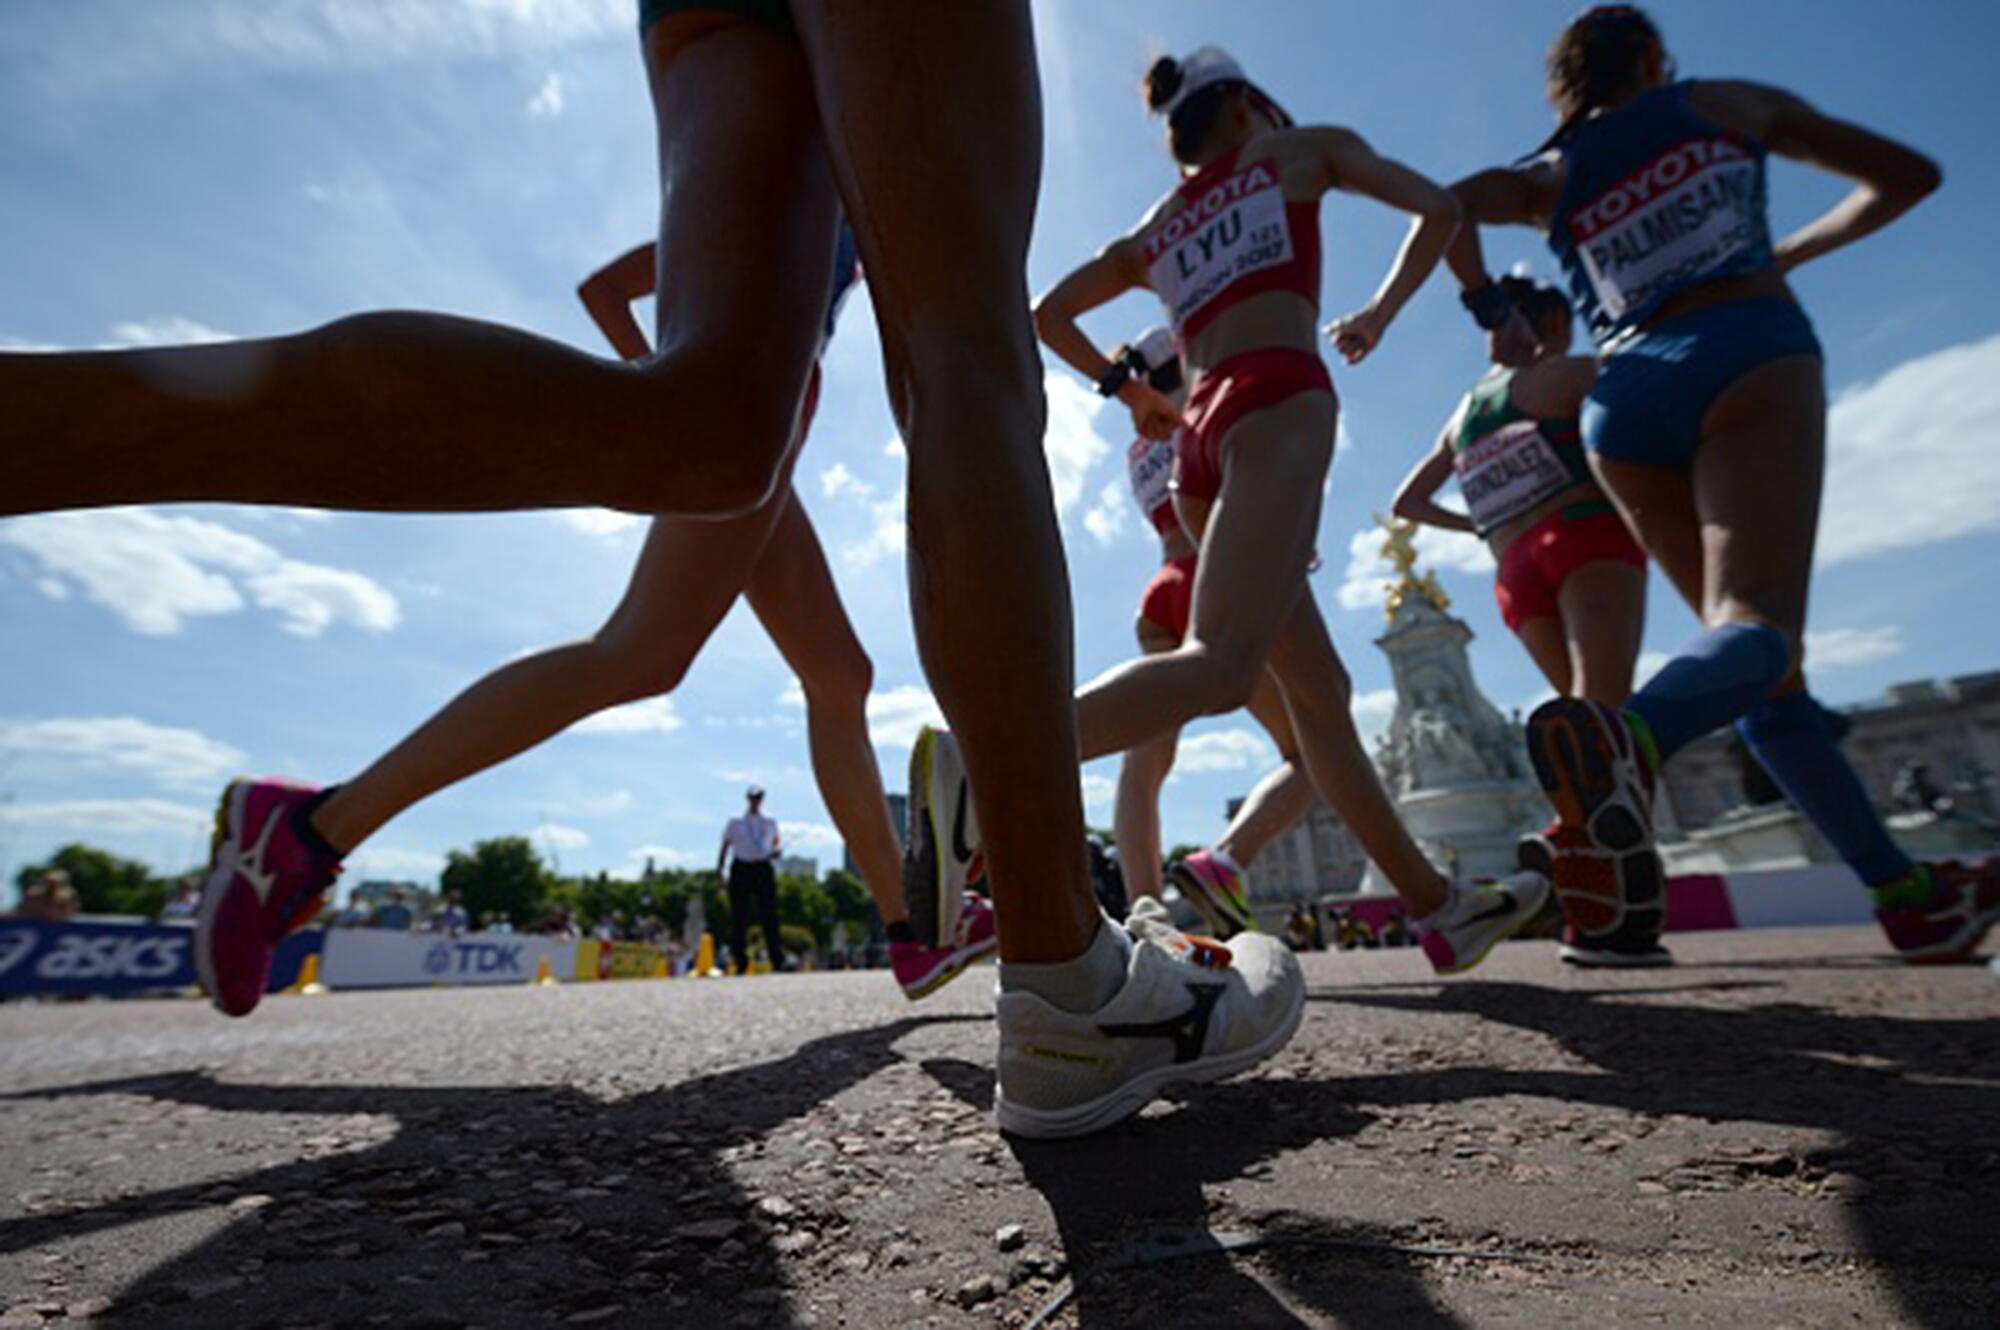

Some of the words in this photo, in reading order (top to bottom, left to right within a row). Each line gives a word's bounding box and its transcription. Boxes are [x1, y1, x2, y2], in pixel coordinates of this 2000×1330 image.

[1146, 166, 1271, 256] TOYOTA
[1573, 139, 1744, 231] TOYOTA
[1176, 208, 1242, 278] LYU
[453, 942, 524, 973] TDK
